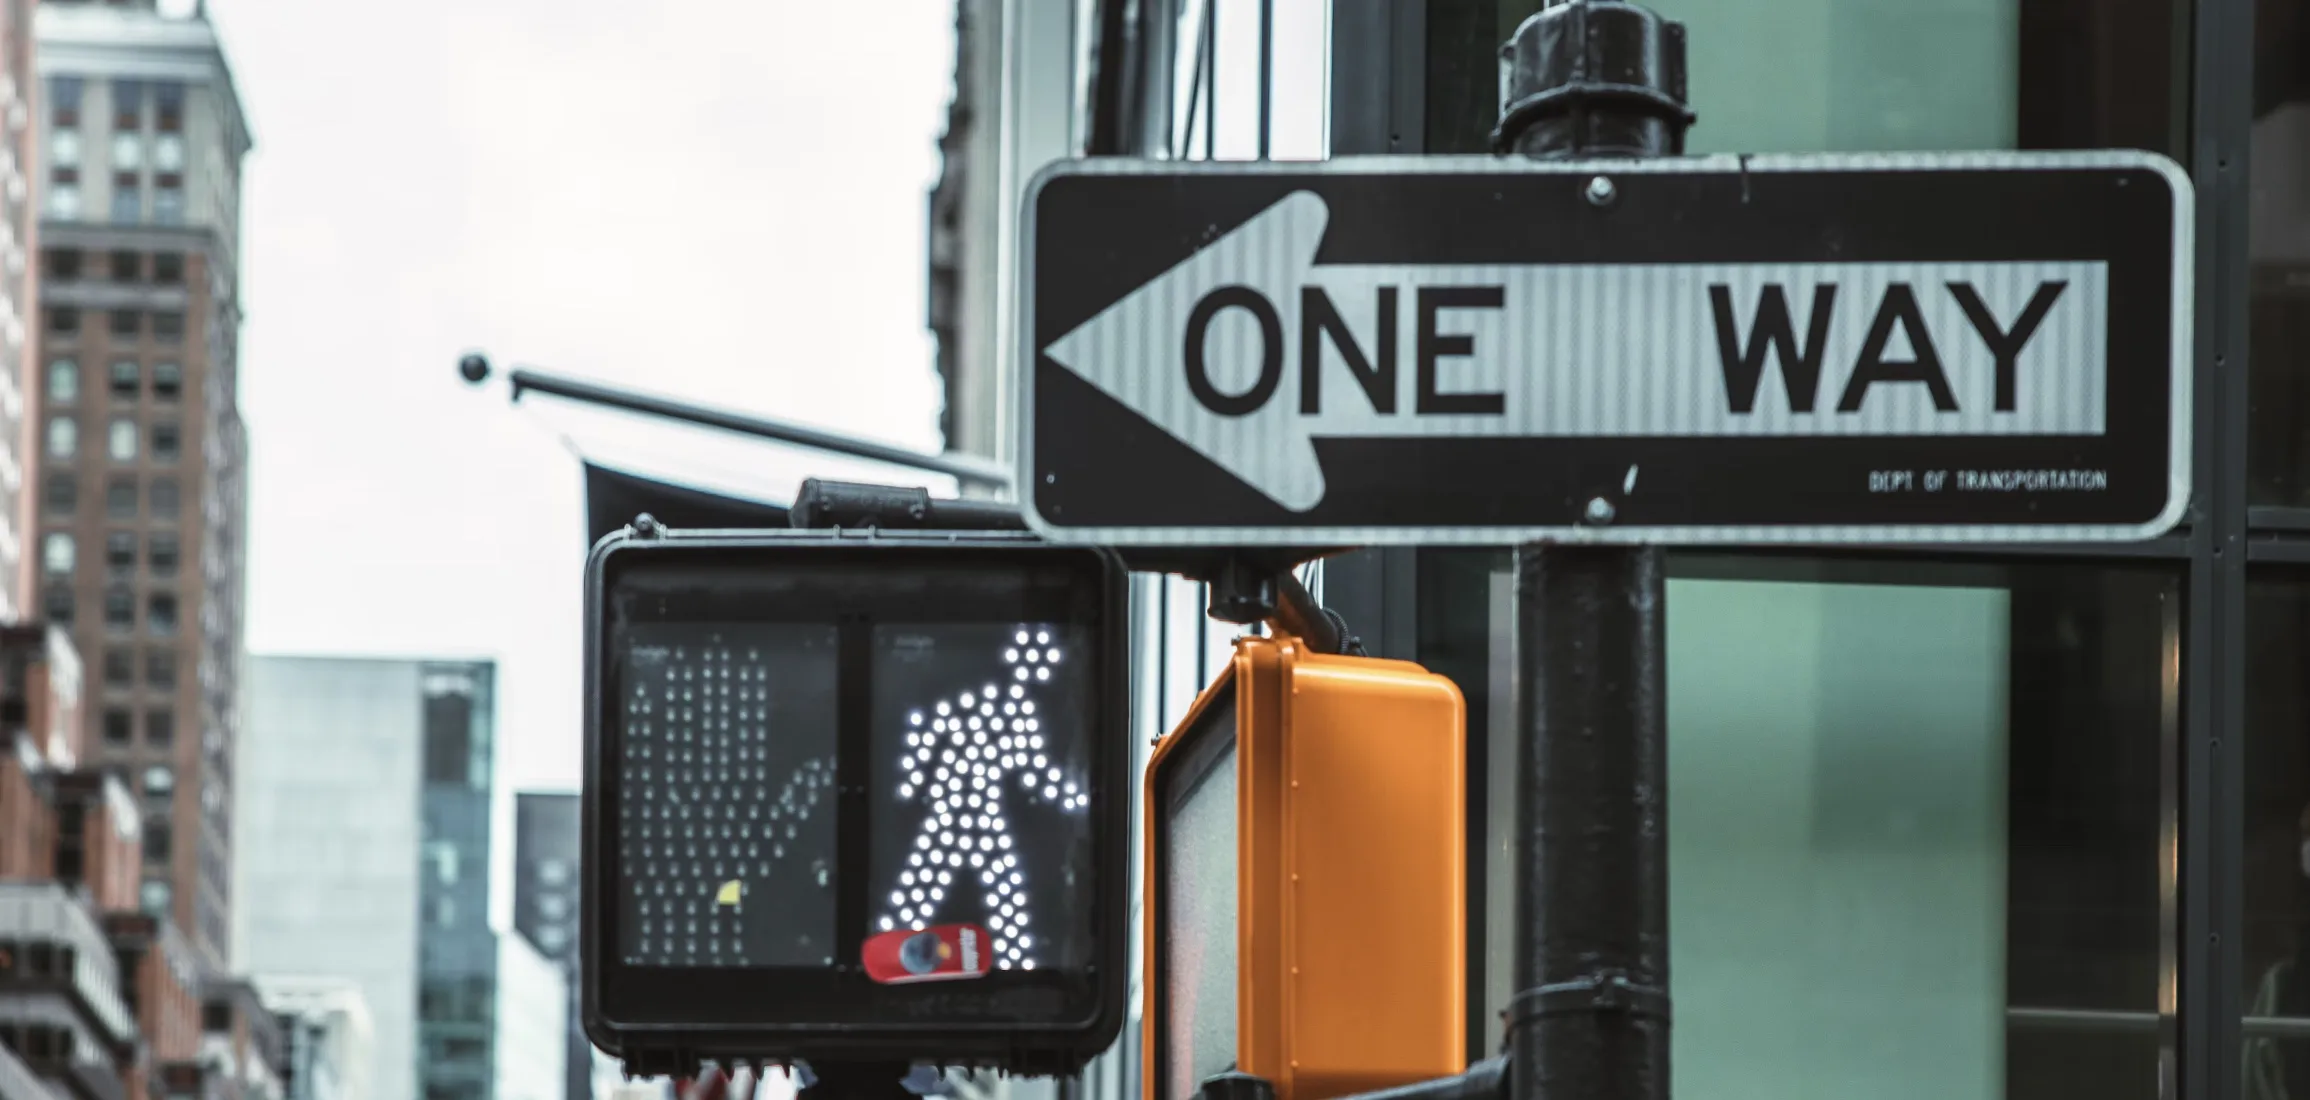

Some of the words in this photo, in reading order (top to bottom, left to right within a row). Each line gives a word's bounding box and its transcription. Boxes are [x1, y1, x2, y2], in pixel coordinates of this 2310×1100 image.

[1184, 285, 1506, 418] ONE
[1708, 281, 2069, 414] WAY
[1868, 470, 1914, 492] DEPT
[1923, 470, 1947, 492] OF
[1956, 469, 2107, 491] TRANSPORTATION
